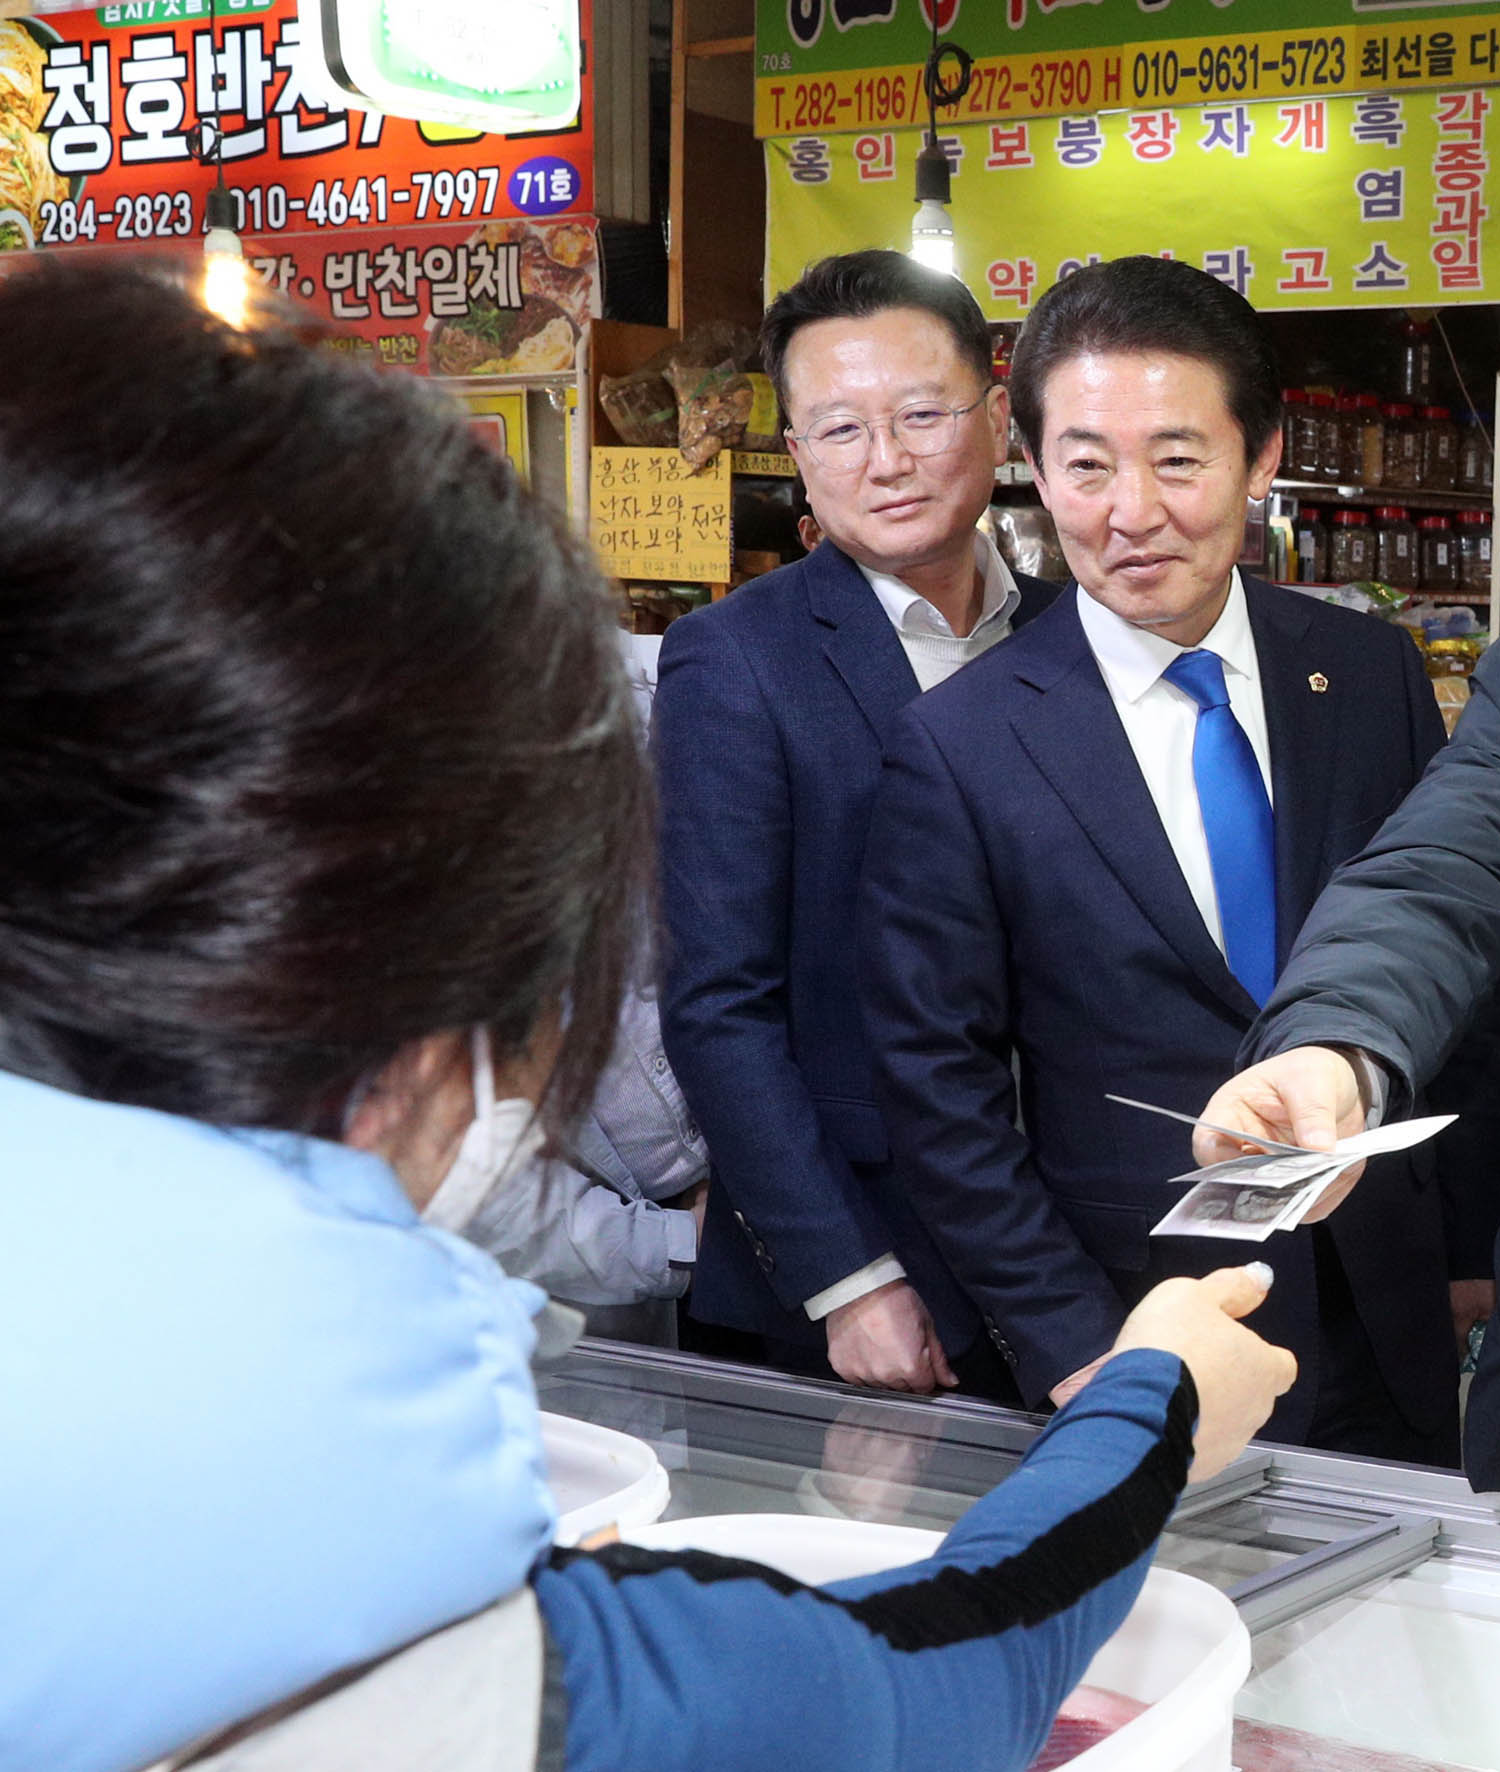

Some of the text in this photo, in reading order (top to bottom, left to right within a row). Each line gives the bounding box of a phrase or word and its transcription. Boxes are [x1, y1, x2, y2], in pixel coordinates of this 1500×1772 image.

[761, 53, 792, 71] 70호
[1133, 36, 1346, 98] 010-9631-5723
[1360, 32, 1457, 81] 최선을
[515, 167, 574, 205] 71호
[39, 191, 193, 244] 284-2823
[323, 242, 523, 319] 반찬일체
